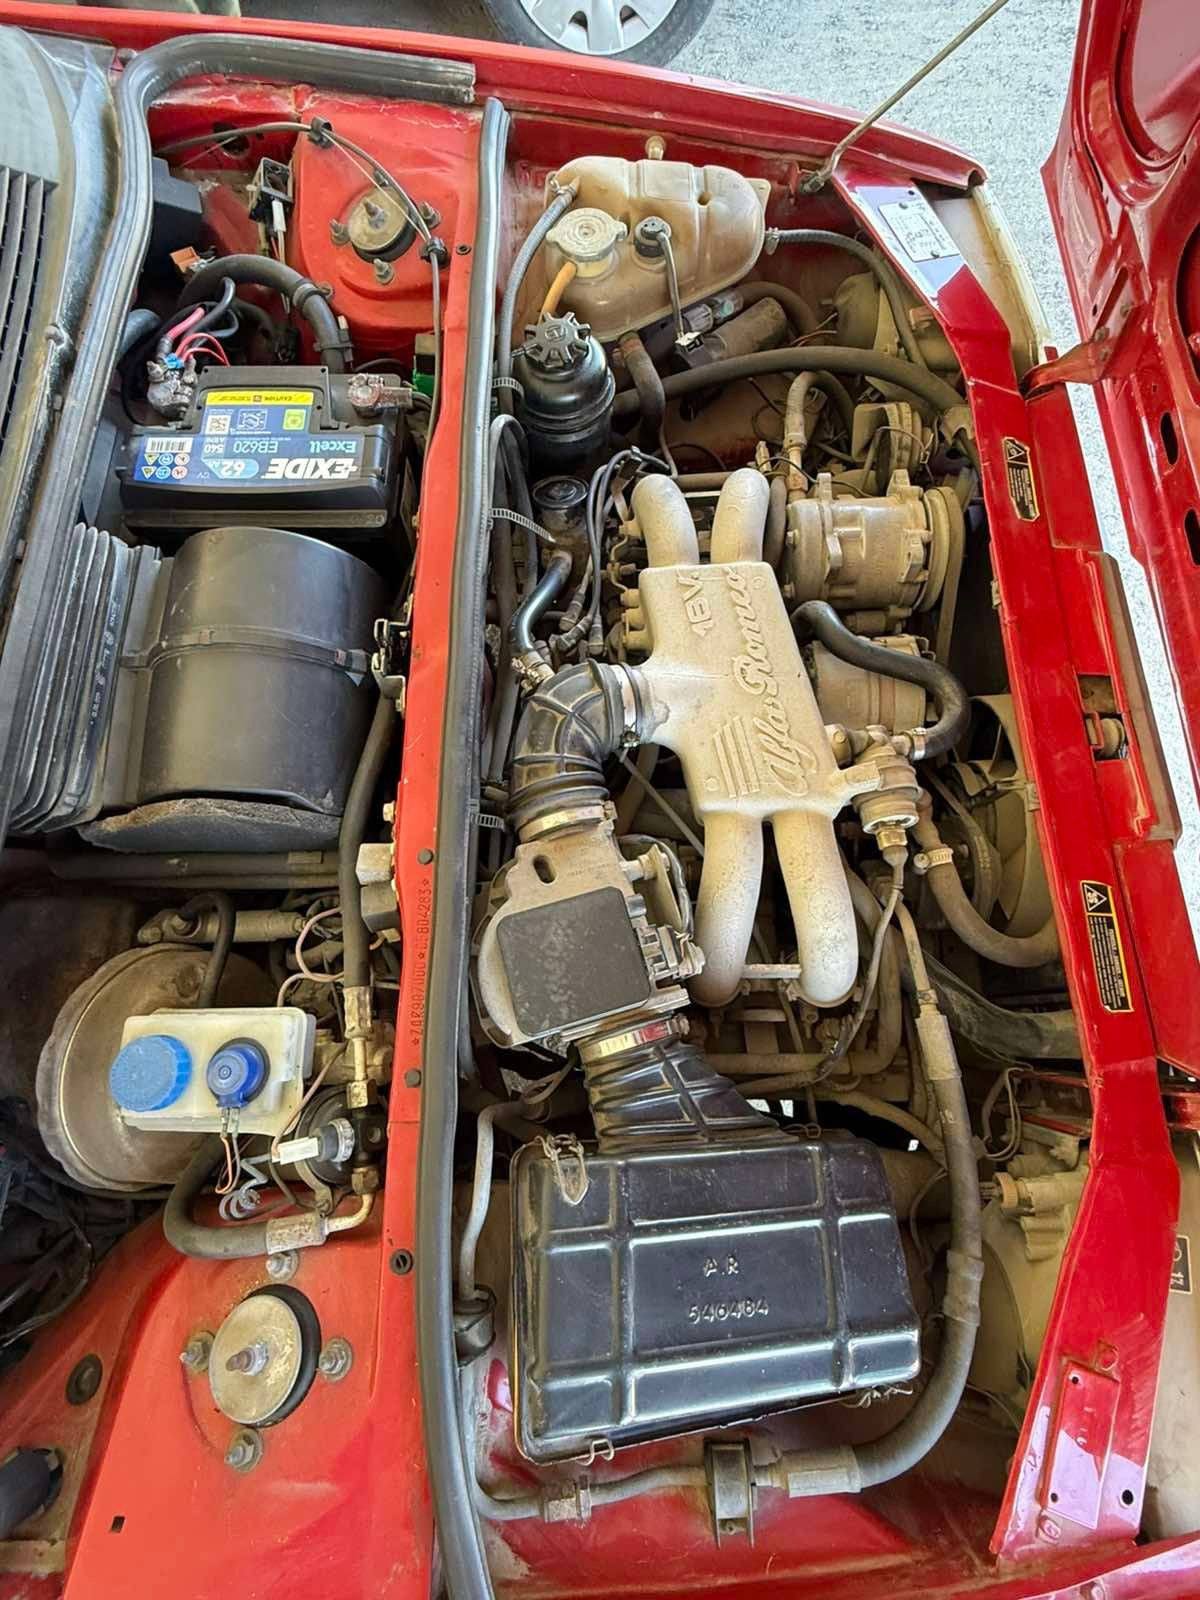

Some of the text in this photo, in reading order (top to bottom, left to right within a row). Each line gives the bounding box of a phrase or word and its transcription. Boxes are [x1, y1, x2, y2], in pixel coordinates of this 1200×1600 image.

[204, 443, 224, 453] 540
[233, 440, 279, 454] EB620
[309, 440, 357, 454] Excell
[264, 458, 358, 480] EXIDE
[728, 567, 818, 796] Alfa Romeo
